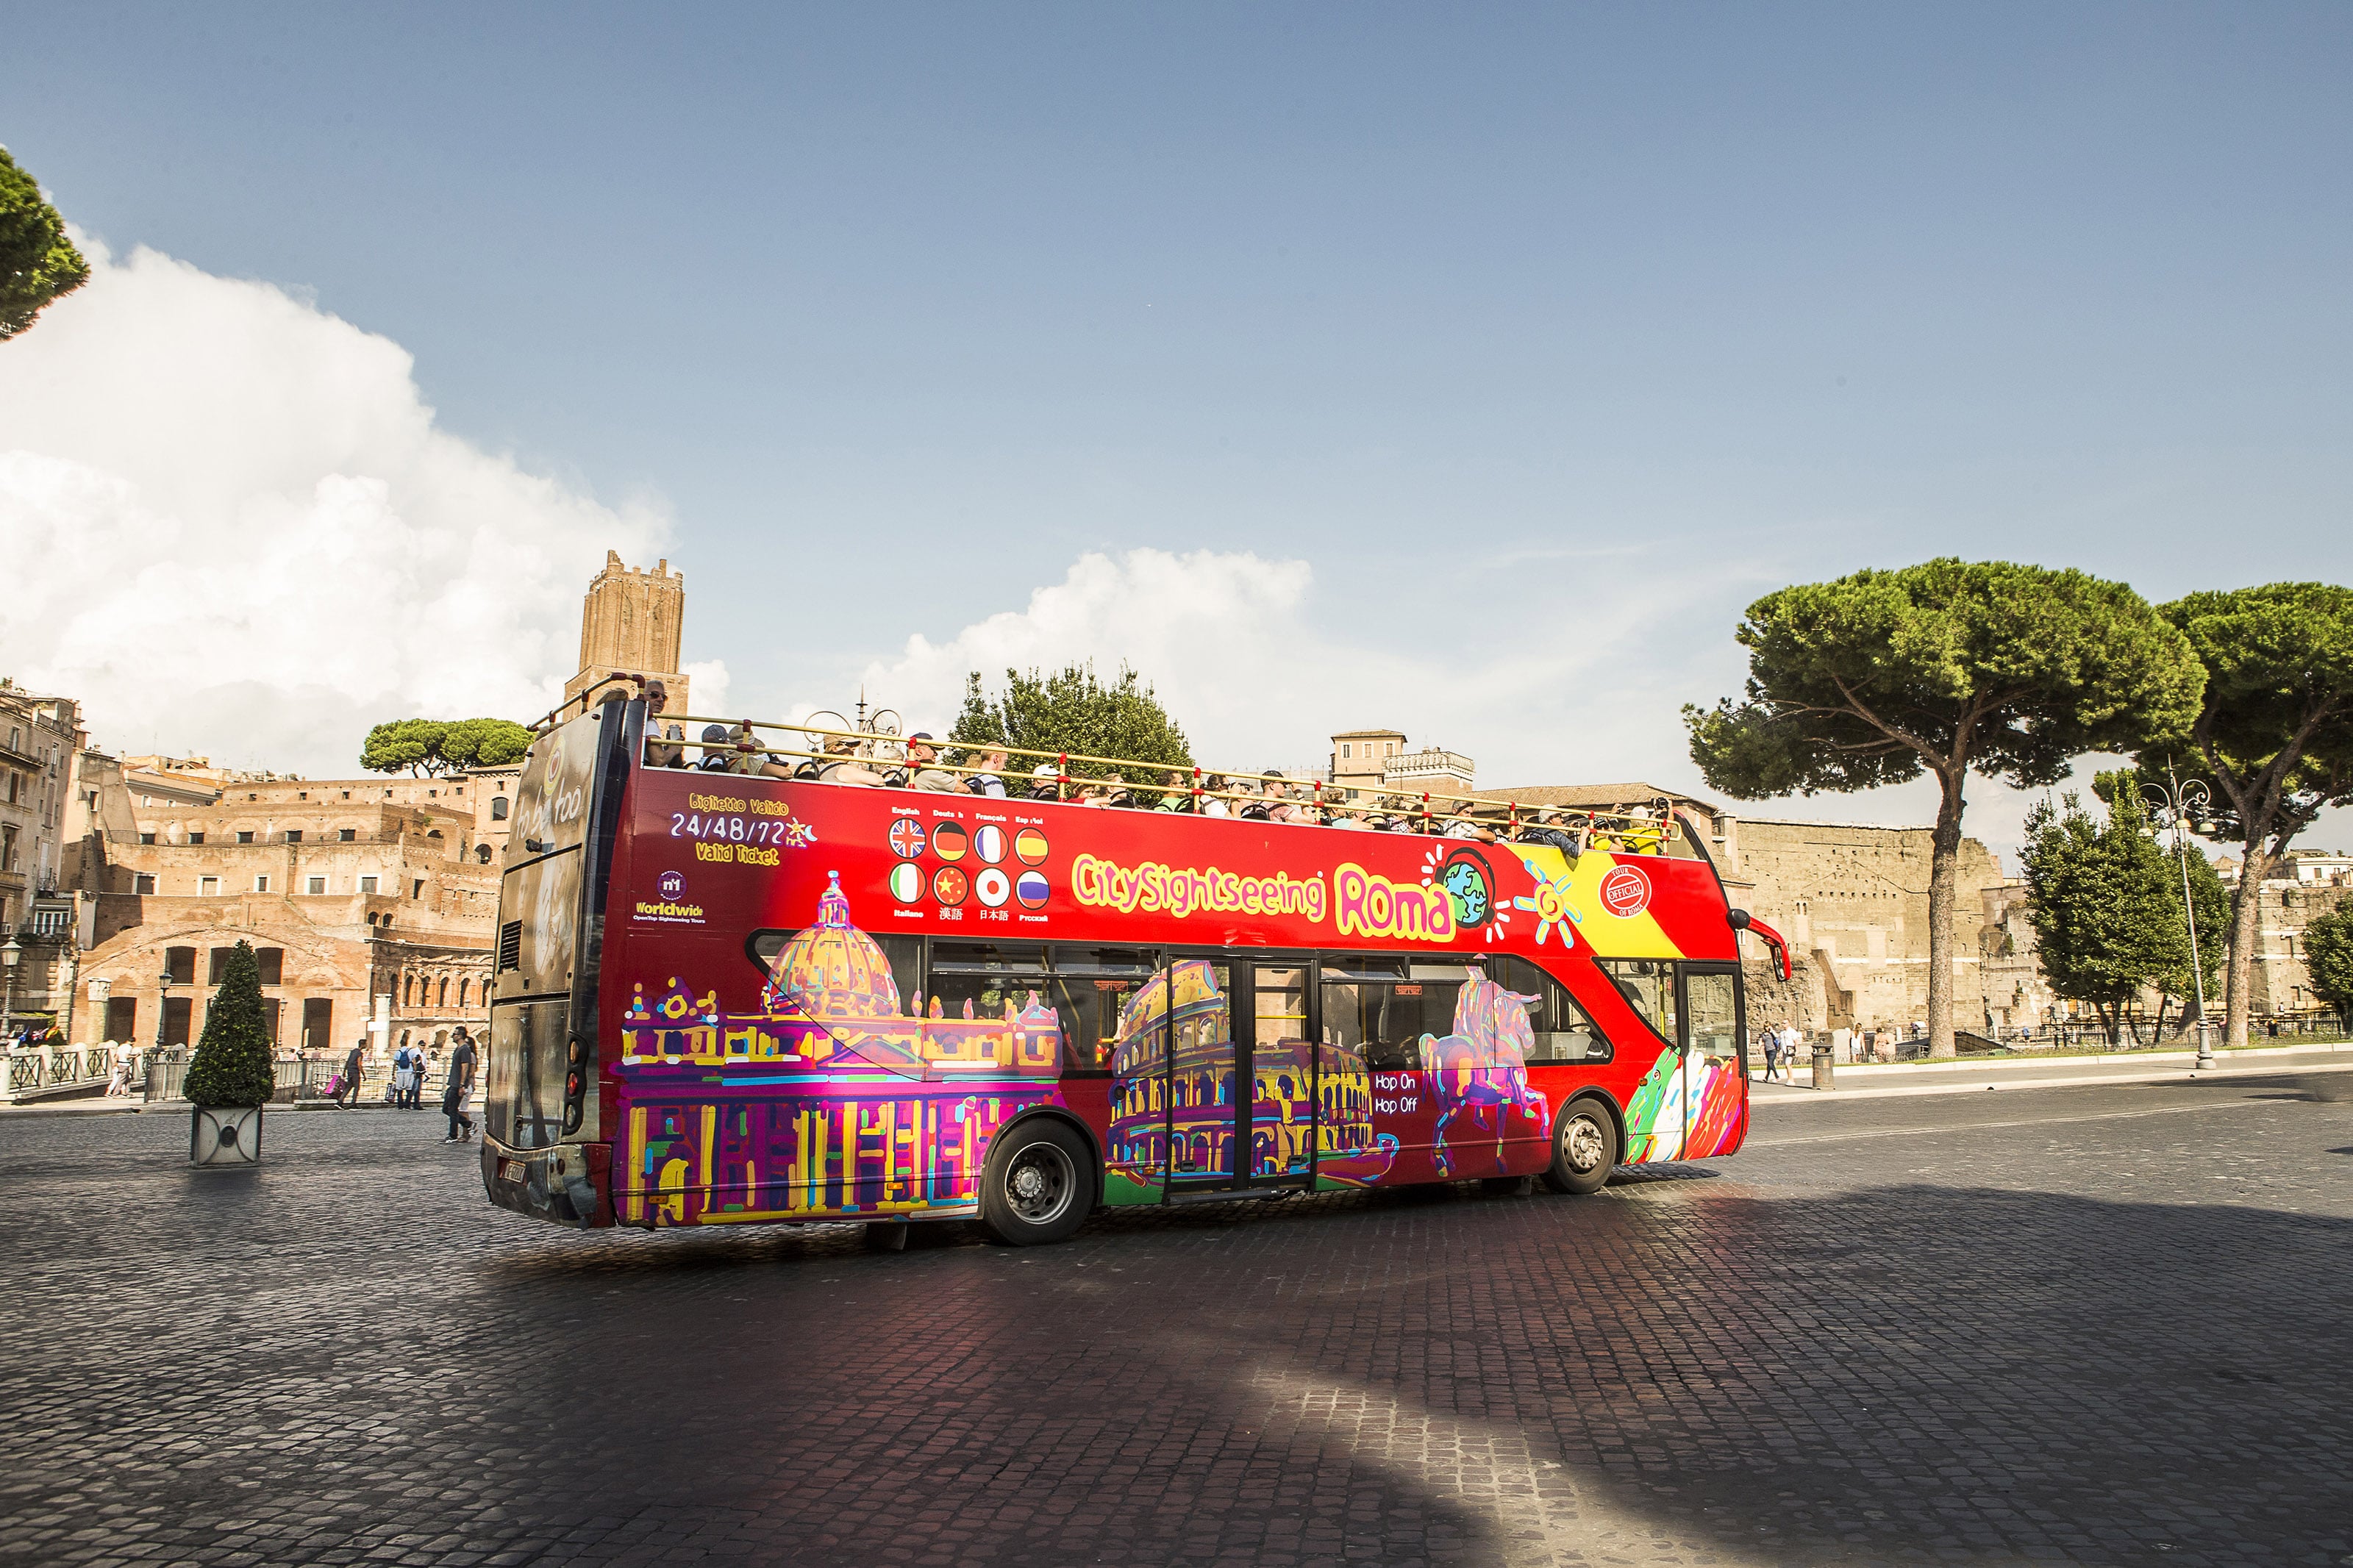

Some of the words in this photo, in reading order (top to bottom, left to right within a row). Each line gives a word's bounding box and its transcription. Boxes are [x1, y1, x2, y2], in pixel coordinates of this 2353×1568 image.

[516, 797, 530, 840] to
[555, 777, 582, 825] too
[689, 792, 746, 812] Biglietto
[750, 799, 789, 817] Valido
[891, 806, 920, 816] English
[932, 809, 964, 819] Deutsh
[975, 813, 1007, 823] Français
[670, 812, 785, 844] 24/48/72
[696, 842, 733, 862] Valid
[735, 845, 781, 866] Ticket
[1611, 867, 1629, 877] TOUR
[1608, 884, 1642, 900] OFFICIAL
[636, 902, 703, 916] Worldwide
[1334, 862, 1457, 942] Roma
[1627, 903, 1643, 916] ROMA
[893, 909, 924, 918] Italiano
[979, 909, 1009, 921] 日本語
[1375, 1075, 1397, 1091] Hop
[1400, 1073, 1415, 1089] On
[1375, 1098, 1397, 1114] Hop
[1400, 1096, 1418, 1112] Off
